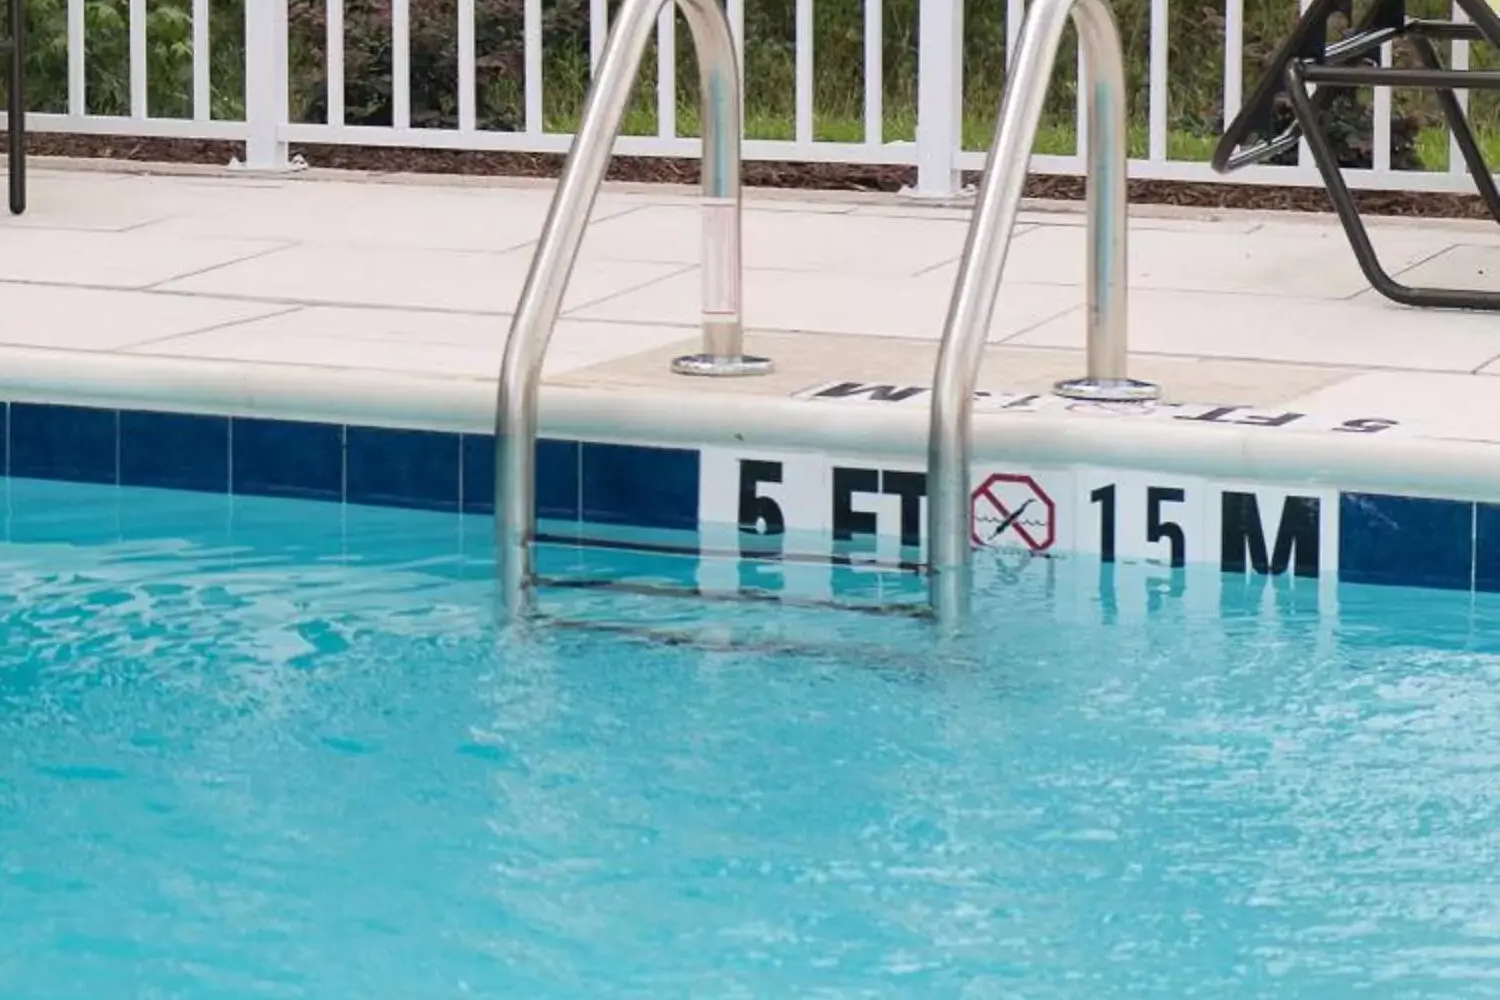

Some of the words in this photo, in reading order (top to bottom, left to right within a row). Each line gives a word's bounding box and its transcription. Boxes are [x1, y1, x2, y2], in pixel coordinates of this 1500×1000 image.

[1331, 418, 1398, 433] 5
[738, 458, 785, 535] 5
[1220, 491, 1321, 579] M
